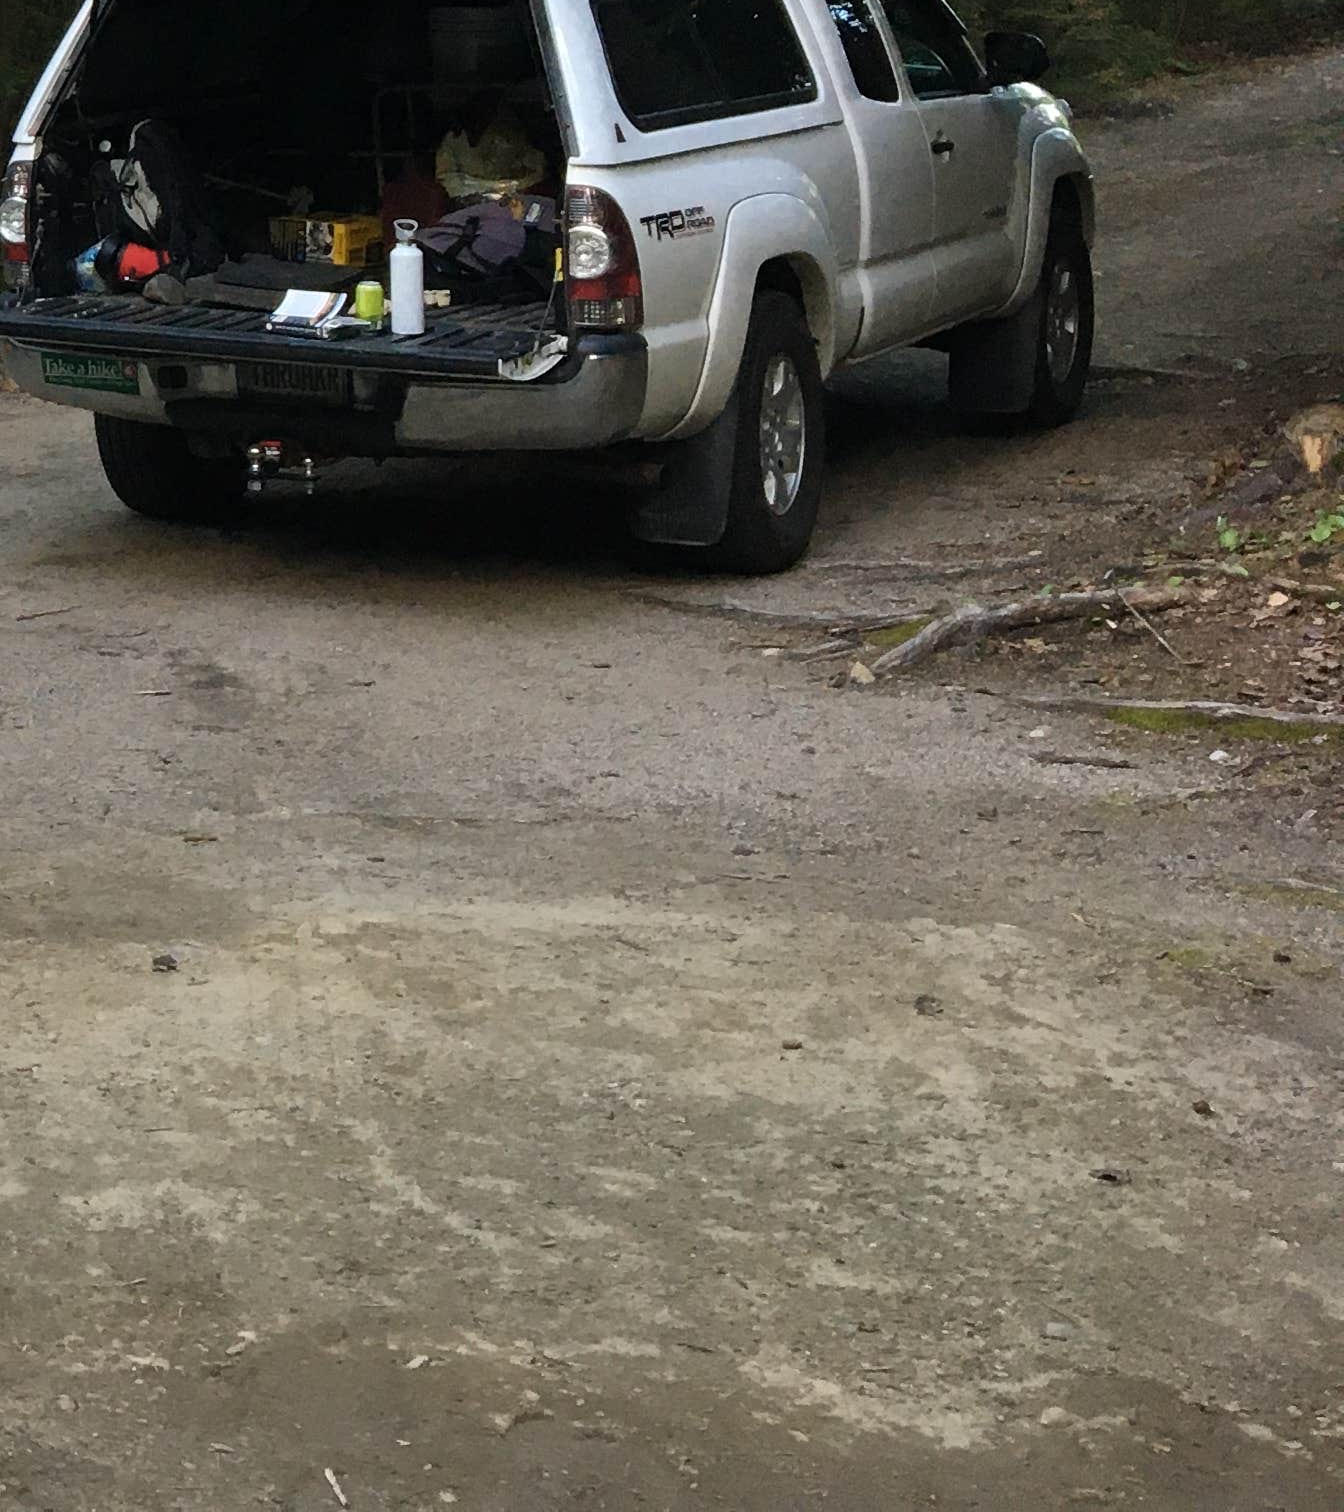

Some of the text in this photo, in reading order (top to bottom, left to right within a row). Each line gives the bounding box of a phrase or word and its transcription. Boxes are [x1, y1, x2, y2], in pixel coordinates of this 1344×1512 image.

[640, 210, 686, 241] TRD
[43, 358, 75, 376] Take
[77, 365, 86, 376] a
